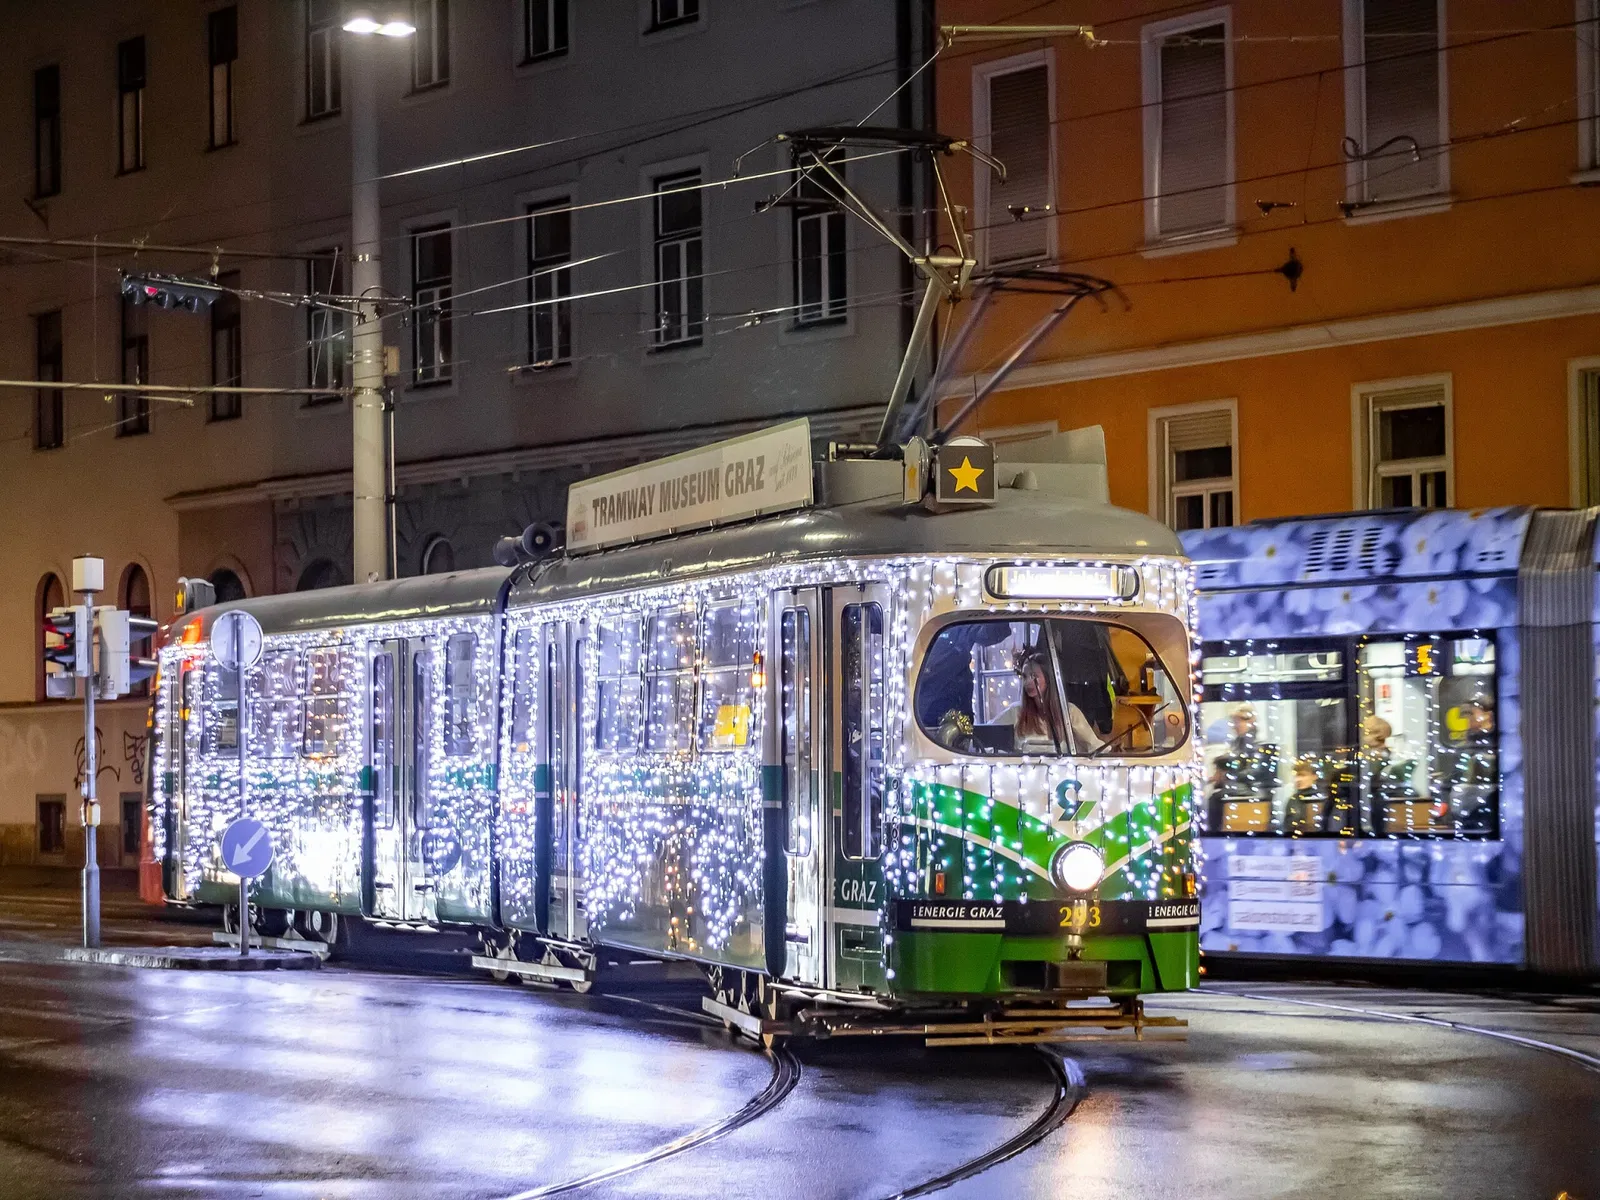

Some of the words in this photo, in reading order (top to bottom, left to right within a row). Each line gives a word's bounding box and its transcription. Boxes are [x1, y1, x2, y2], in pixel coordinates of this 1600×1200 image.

[592, 484, 656, 528] TRAMWAY
[659, 467, 720, 513] MUSEUM
[724, 455, 765, 498] GRAZ
[841, 878, 877, 903] GRAZ
[918, 906, 966, 918] ENERGIE
[970, 907, 1004, 918] GRAZ
[1059, 906, 1101, 927] 293
[1154, 905, 1189, 917] ENERGIE
